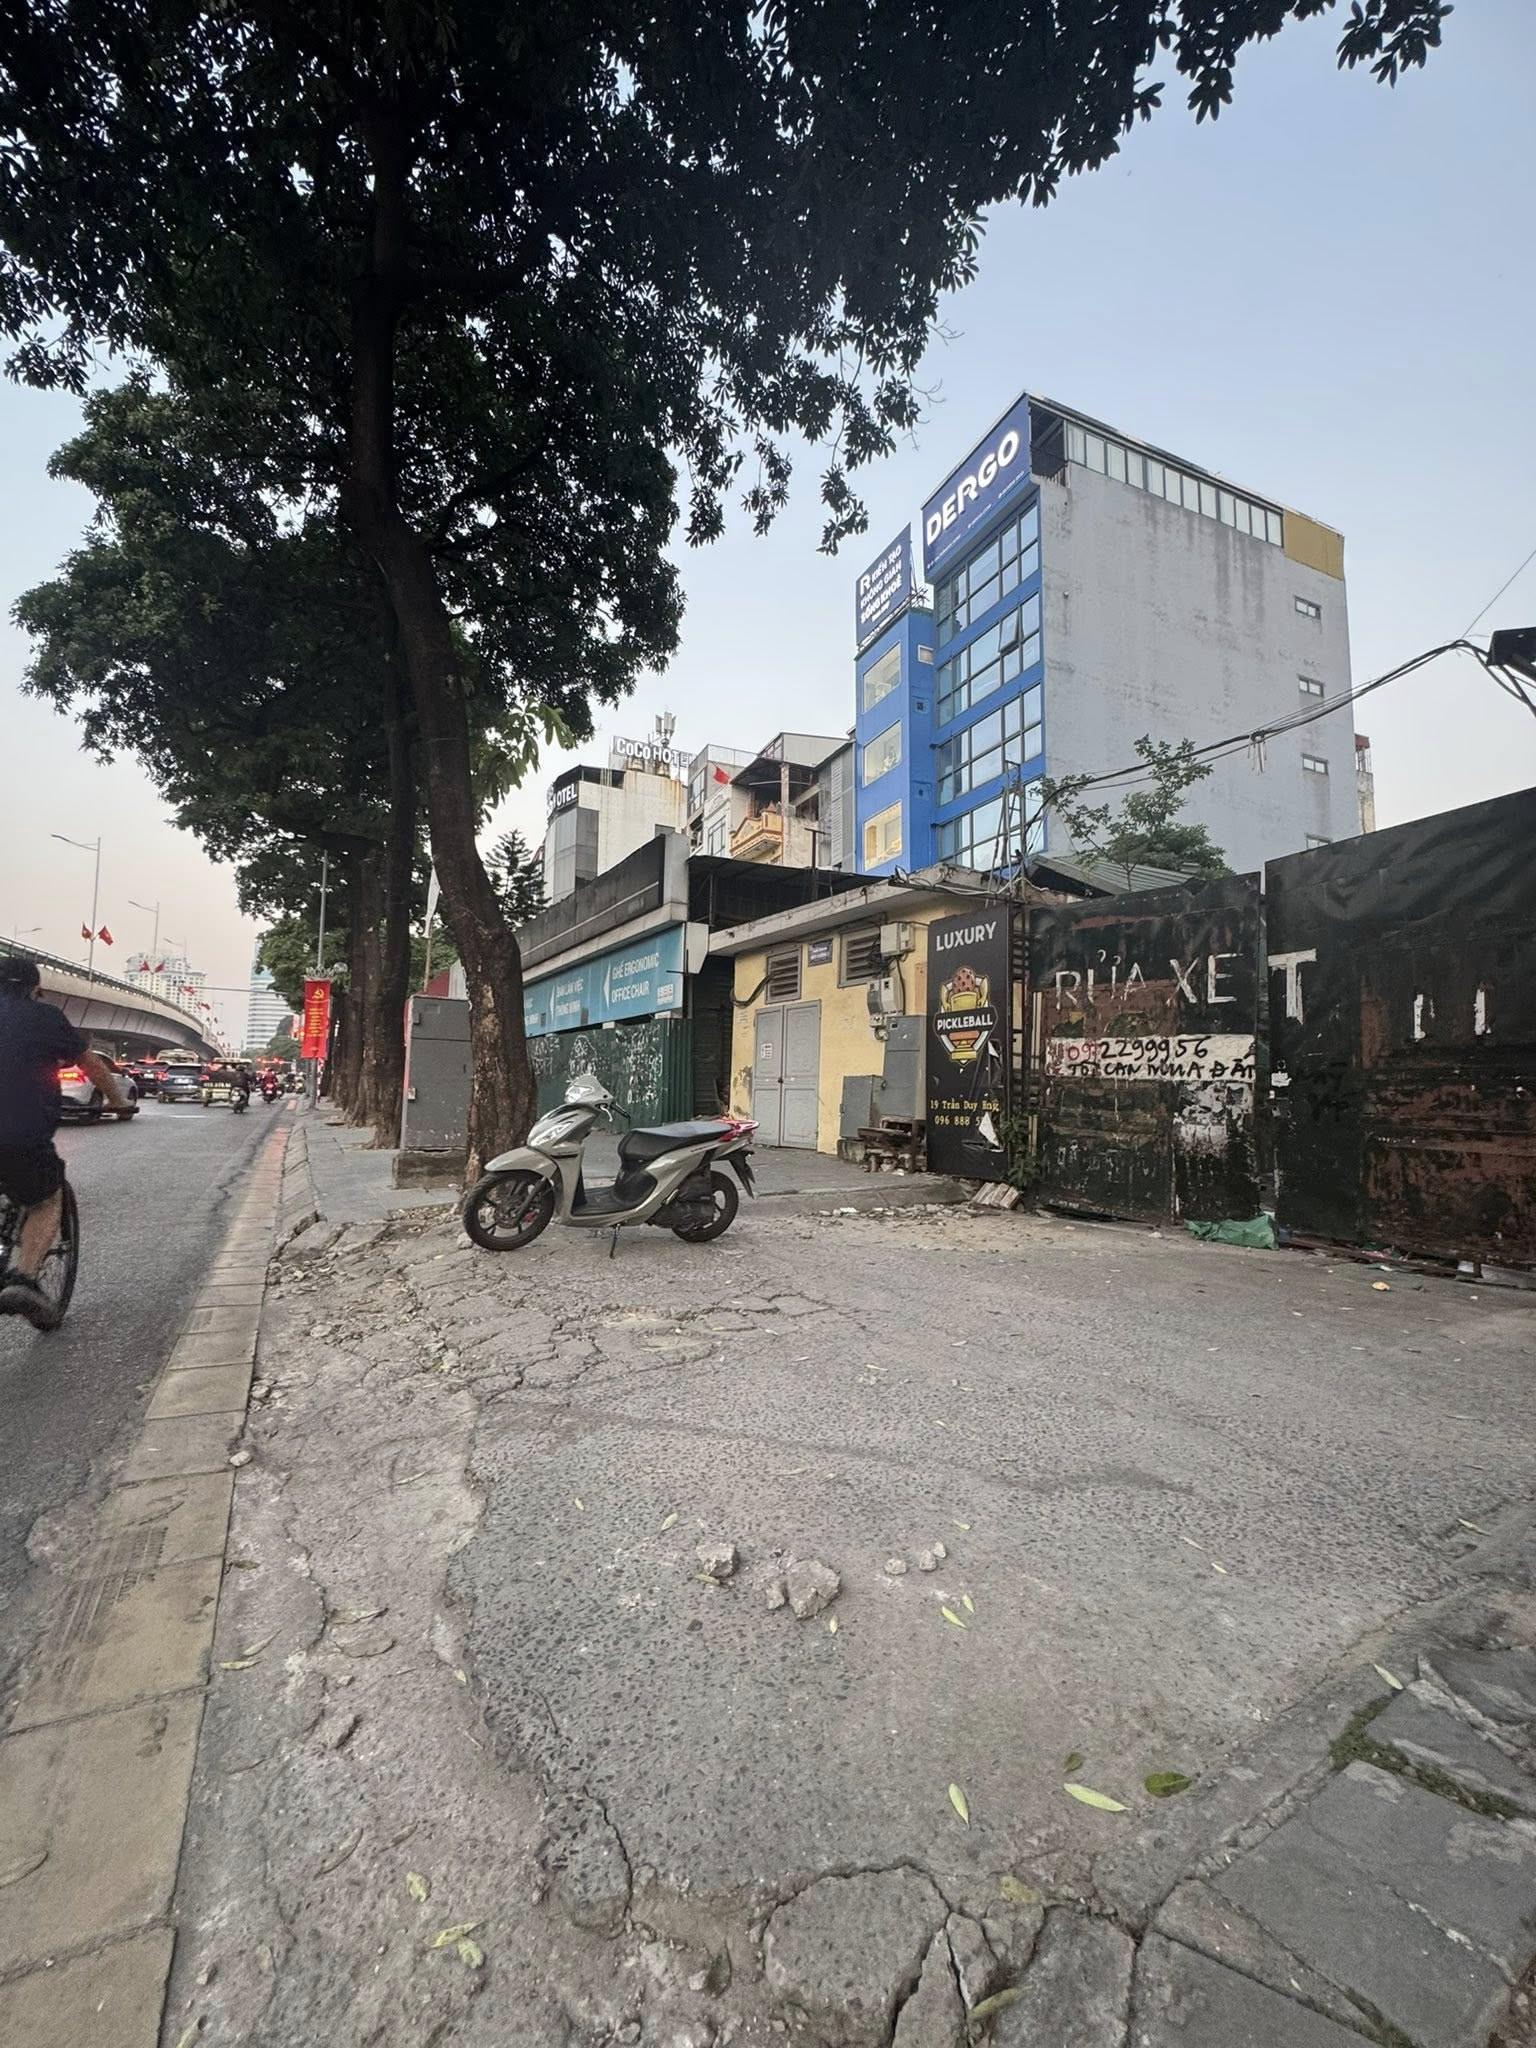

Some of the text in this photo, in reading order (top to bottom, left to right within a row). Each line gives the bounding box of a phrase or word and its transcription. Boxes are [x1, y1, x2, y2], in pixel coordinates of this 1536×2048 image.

[926, 430, 1020, 546] DERGO
[884, 559, 902, 584] GIAN
[935, 921, 997, 951] LUXURY
[624, 952, 660, 977] ERGONOMIC
[611, 984, 631, 1003] OFFICE
[631, 980, 650, 999] CHAIR
[1165, 952, 1244, 1006] XE
[937, 1013, 993, 1031] PICKLEBALL
[930, 1100, 939, 1110] 19
[963, 1100, 978, 1112] Duy
[934, 1115, 950, 1125] 096
[954, 1115, 970, 1126] 888
